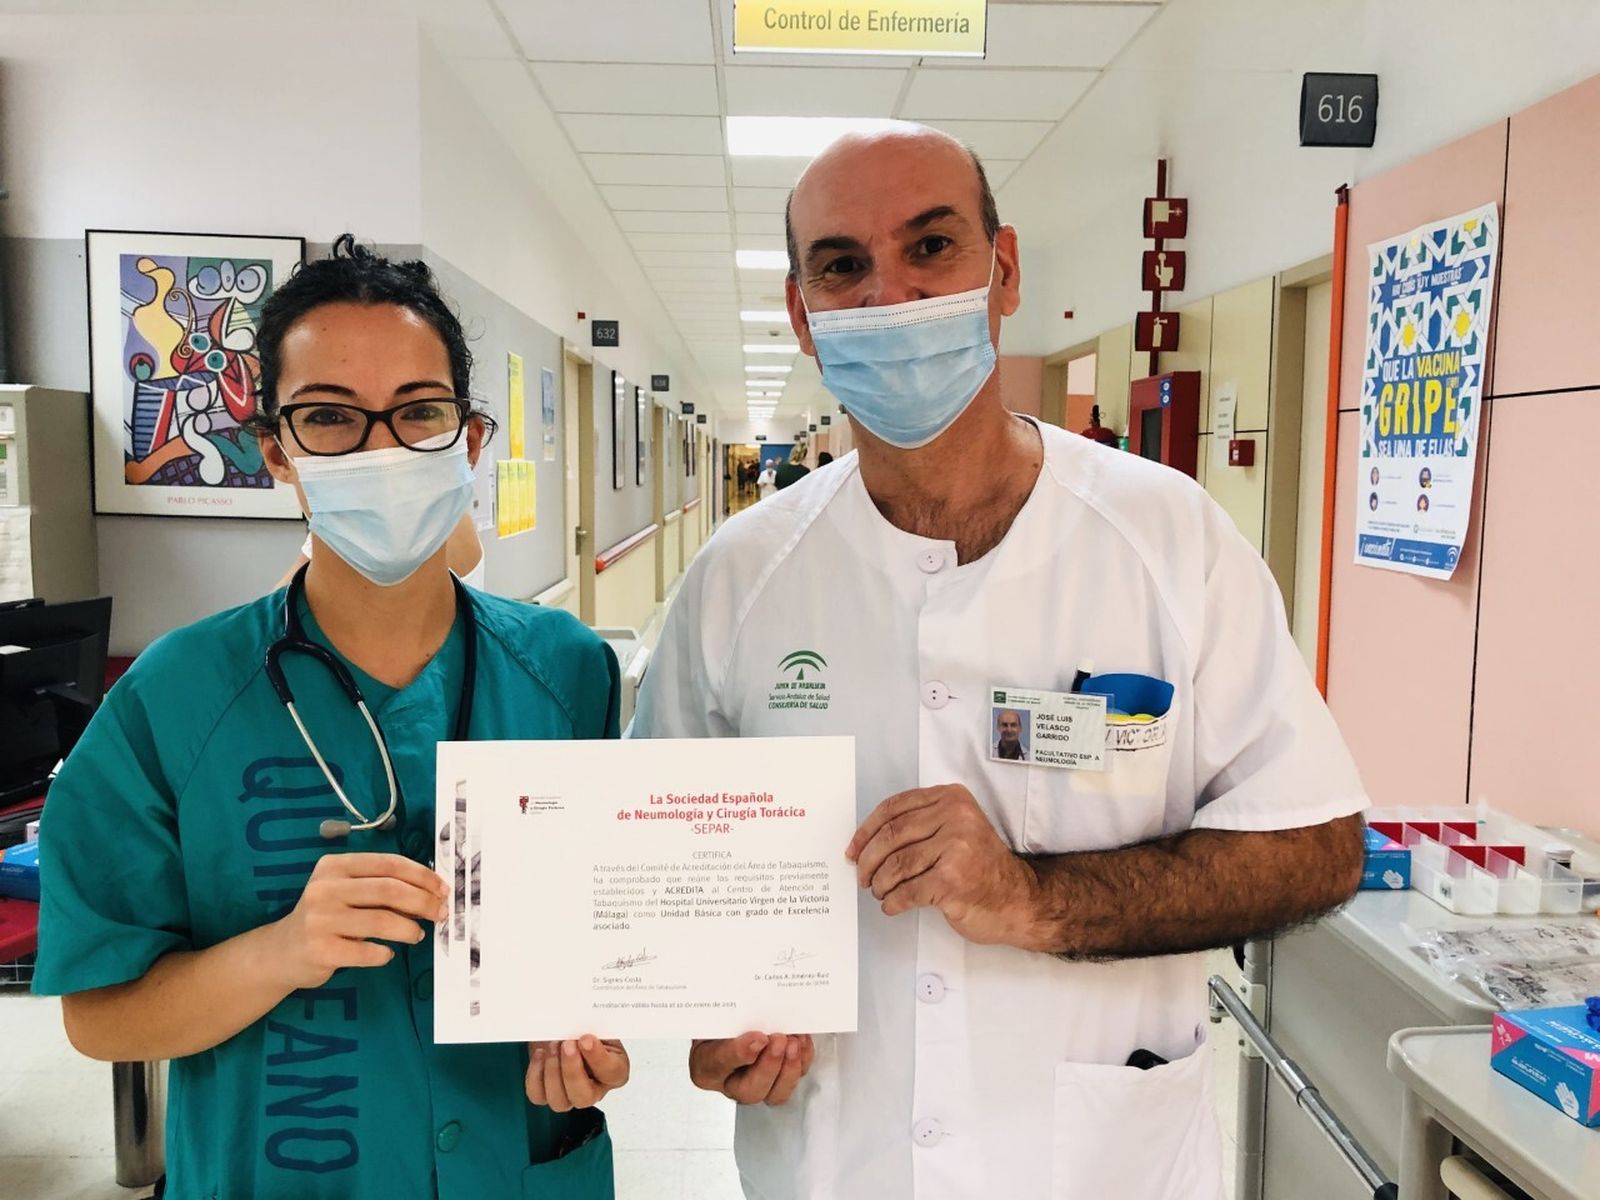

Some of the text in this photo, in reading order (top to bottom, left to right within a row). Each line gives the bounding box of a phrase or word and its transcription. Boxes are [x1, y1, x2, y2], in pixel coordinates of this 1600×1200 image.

[764, 8, 970, 33] Control de Enfermería
[1318, 94, 1363, 123] 616
[596, 327, 616, 340] 632
[1383, 350, 1460, 382] QUE LA VACUNA
[1379, 379, 1459, 437] GRIPE
[1378, 438, 1455, 458] SEA UNA DE ELLAS
[167, 496, 233, 506] PABLO PICASSO
[800, 701, 808, 709] DE
[809, 702, 829, 710] SALUD
[1056, 715, 1073, 723] LUIS
[1036, 723, 1070, 732] VELASCO
[1036, 732, 1070, 742] GARRIDO
[1036, 749, 1078, 759] FACULTATIVO
[650, 792, 774, 805] La Sociedad Española
[617, 806, 806, 822] de Neumología y Cirugía Torácica
[690, 823, 734, 835] -SEPAR-
[692, 851, 733, 860] CERTIFICA
[593, 864, 599, 872] A
[599, 864, 625, 872] través
[626, 864, 639, 872] del
[641, 863, 670, 872] Comité
[682, 862, 732, 871] Acreditación
[733, 862, 747, 870] del
[748, 861, 766, 870] Área
[767, 861, 777, 869] de
[779, 860, 829, 870] Tabaquismo,
[593, 876, 604, 884] ha
[609, 876, 661, 885] comprobado
[666, 876, 682, 884] que
[734, 874, 774, 883] requisitos
[779, 872, 829, 882] previamente
[593, 887, 645, 895] establecidos
[664, 886, 704, 894] ACREDITA
[727, 885, 753, 893] Centro
[761, 885, 771, 893] de
[779, 883, 814, 892] Atención
[822, 883, 829, 891] al
[593, 899, 643, 907] Tabaquismo
[660, 898, 695, 907] Hospital
[696, 897, 748, 906] Universitario
[749, 896, 775, 905] Virgen
[777, 896, 788, 904] de
[789, 895, 797, 903] la
[799, 894, 830, 903] Victoria
[593, 910, 628, 920] (Málaga)
[661, 909, 690, 918] Unidad
[694, 908, 722, 917] Básica
[725, 909, 741, 917] con
[745, 908, 768, 917] grado
[773, 908, 783, 916] de
[788, 906, 830, 915] Excelencia
[593, 922, 631, 930] asociado.
